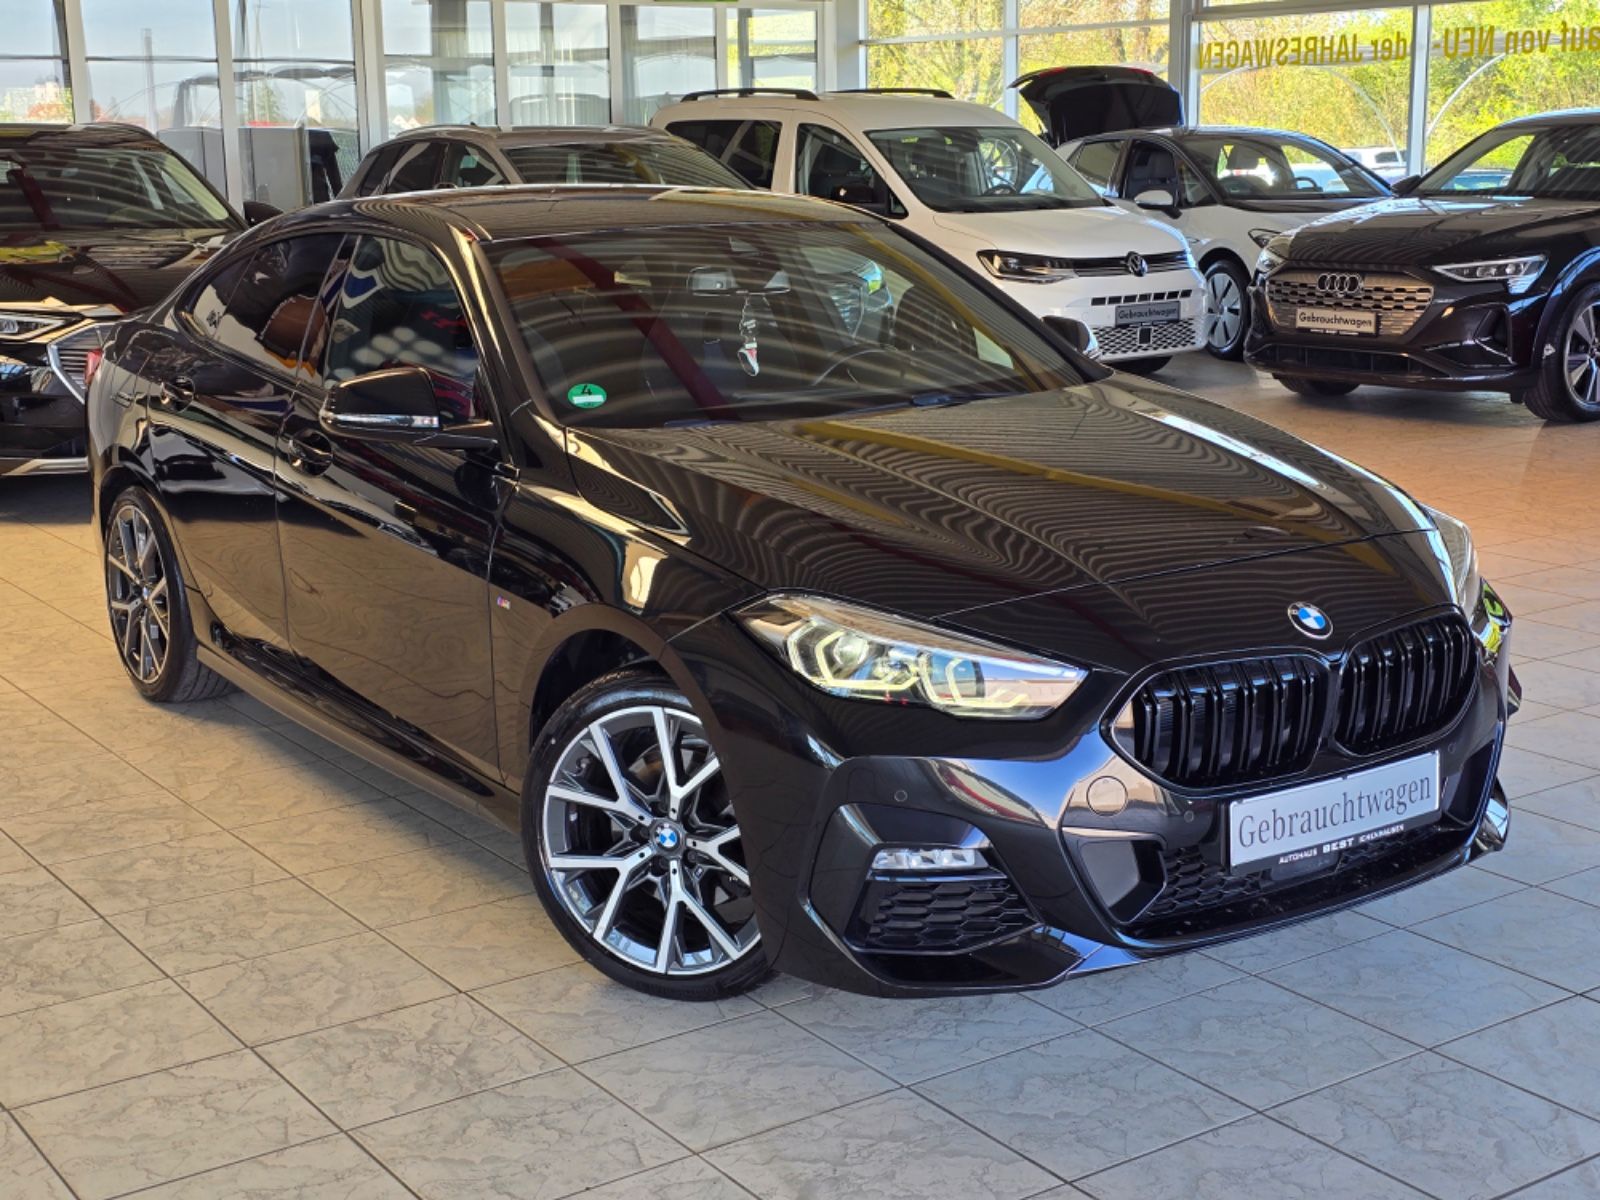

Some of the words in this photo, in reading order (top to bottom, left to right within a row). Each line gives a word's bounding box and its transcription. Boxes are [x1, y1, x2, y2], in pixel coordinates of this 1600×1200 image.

[1298, 311, 1373, 329] Gebrauchtwagen
[581, 384, 593, 396] 4
[1239, 775, 1432, 848] Gebrauchtwagen
[1278, 847, 1318, 865] AUTOHAUS
[1322, 837, 1355, 854] BEST
